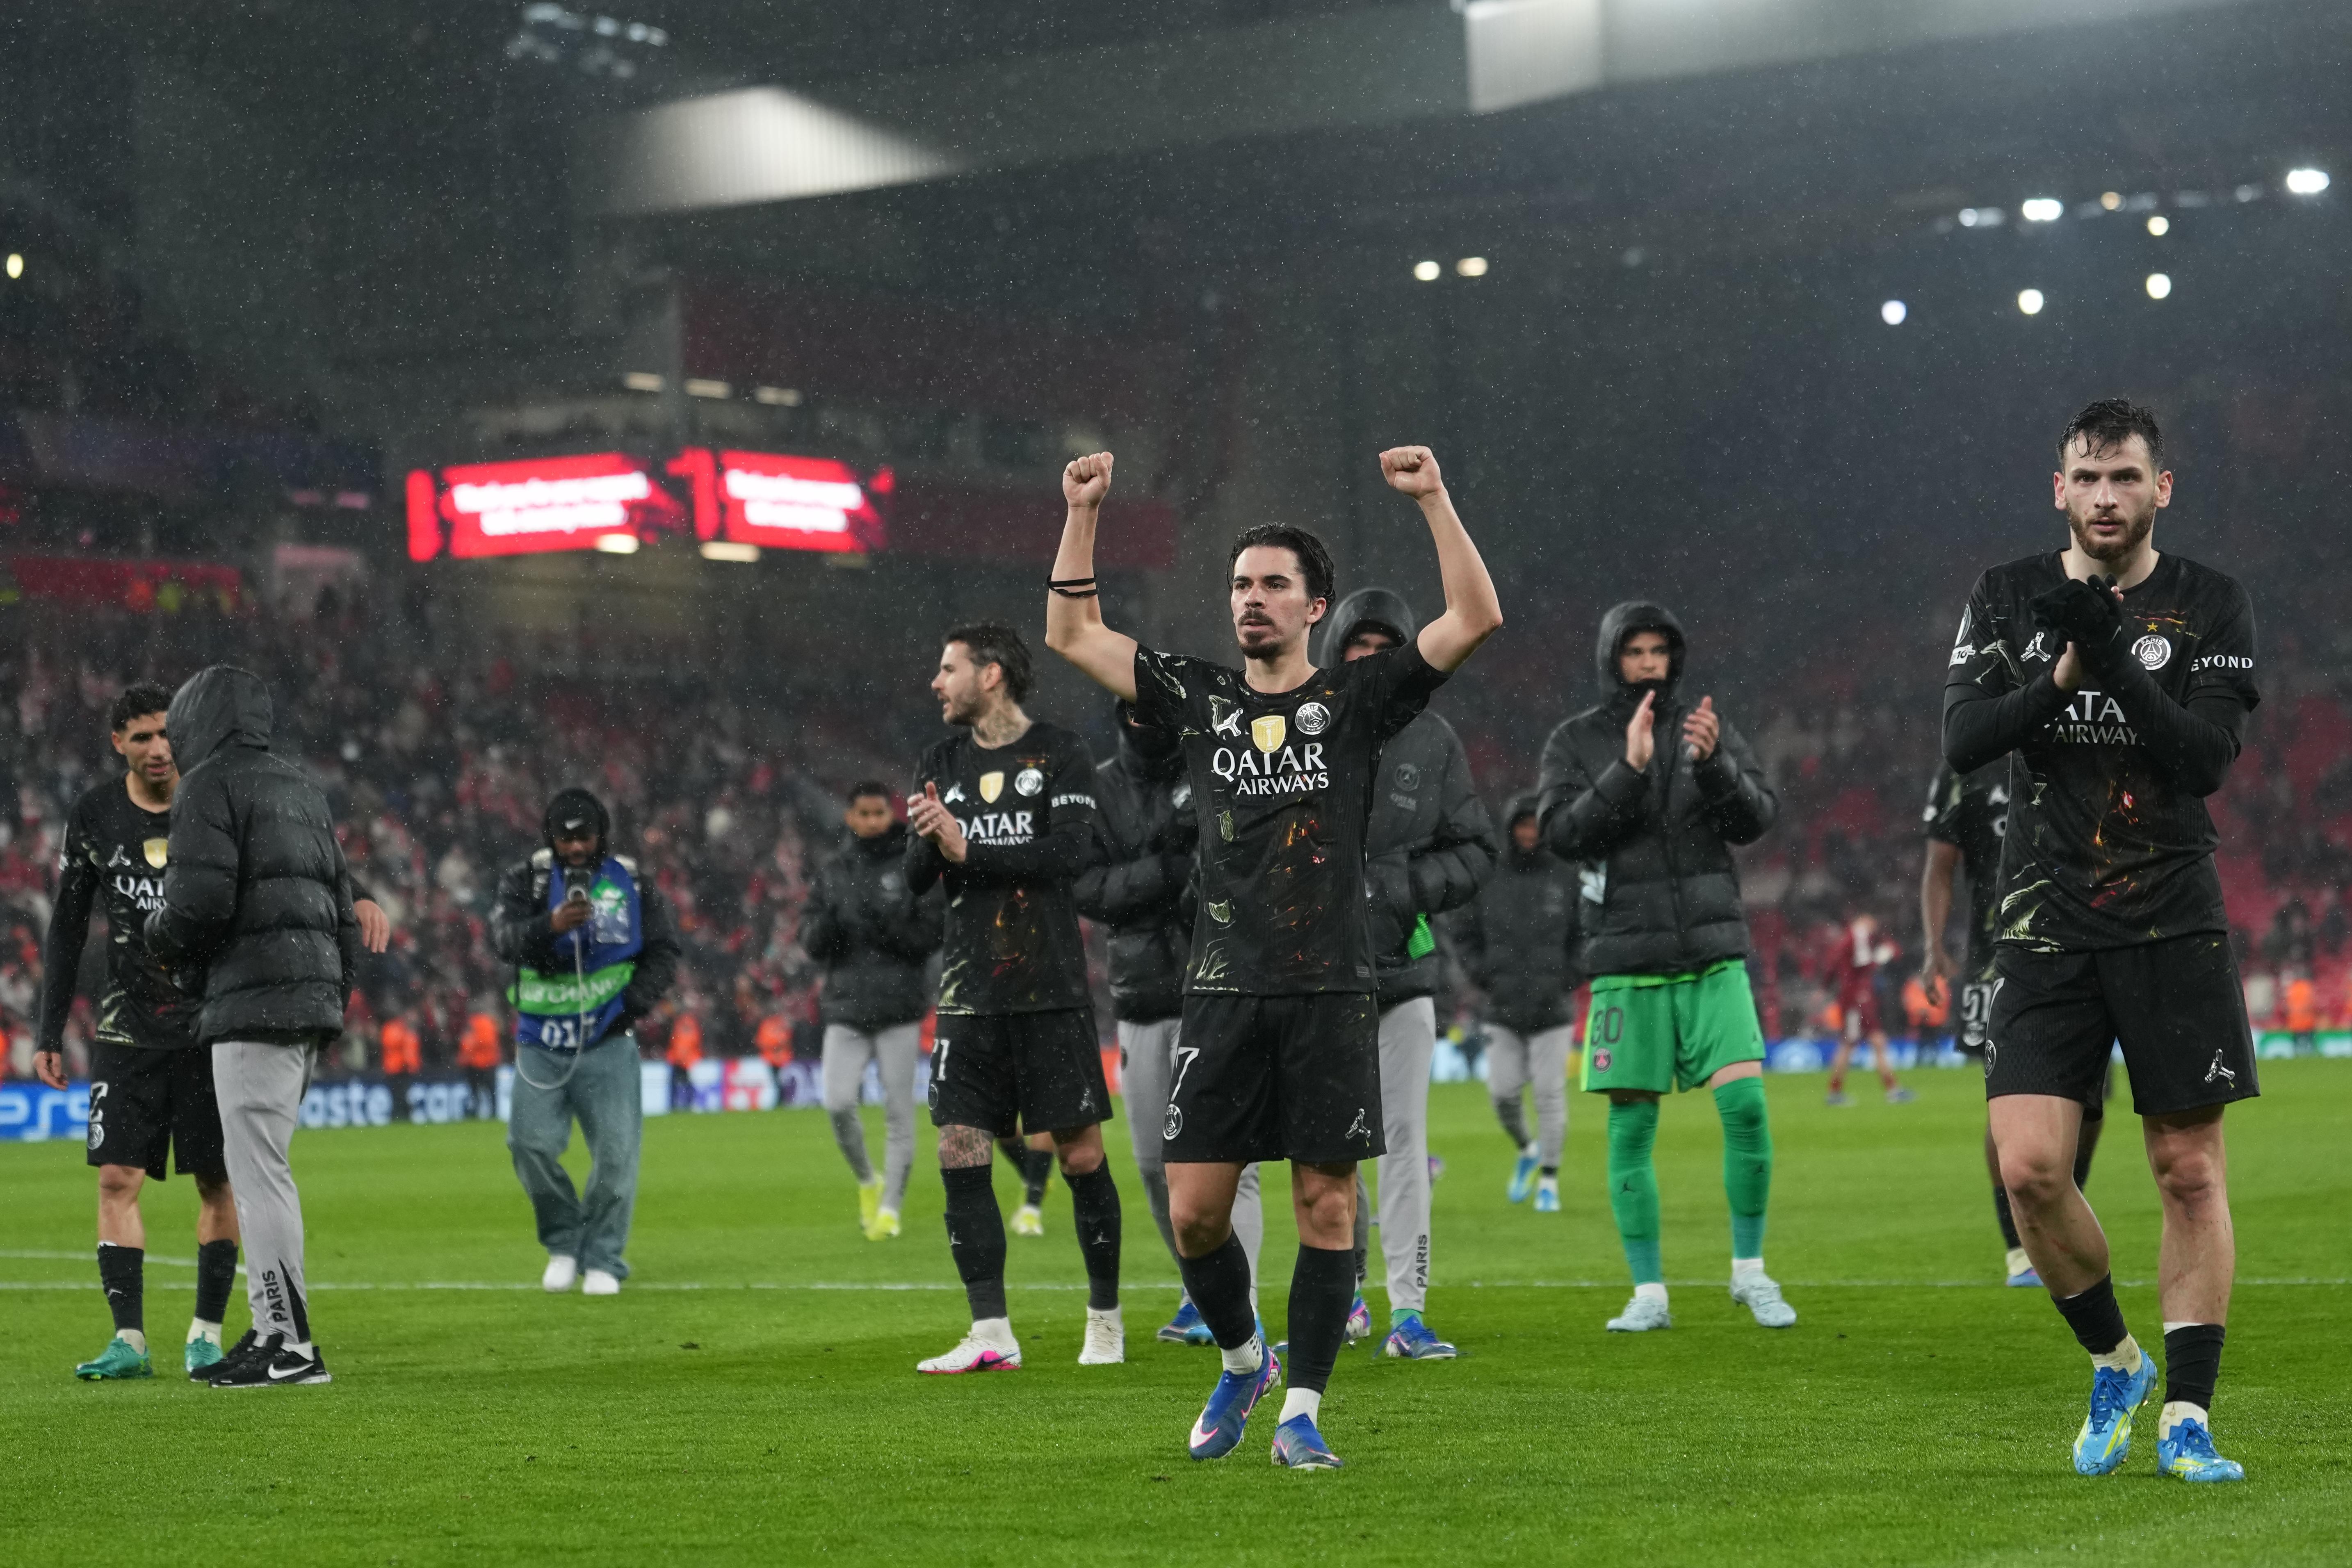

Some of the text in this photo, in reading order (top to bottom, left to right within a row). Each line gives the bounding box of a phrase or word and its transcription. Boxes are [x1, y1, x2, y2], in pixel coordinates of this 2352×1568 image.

[2140, 637, 2163, 645] PARIS
[2191, 654, 2253, 672] EYOND
[1299, 706, 1319, 718] PARIS
[2054, 691, 2126, 723] ATA
[2052, 724, 2138, 745] AIRWAY
[1236, 772, 1329, 795] AIRWAYS
[111, 874, 164, 900] QAT
[1590, 1006, 1623, 1047] 30
[1170, 1047, 1200, 1102] 7
[1416, 1234, 1428, 1288] PARIS
[262, 1270, 289, 1323] PARIS
